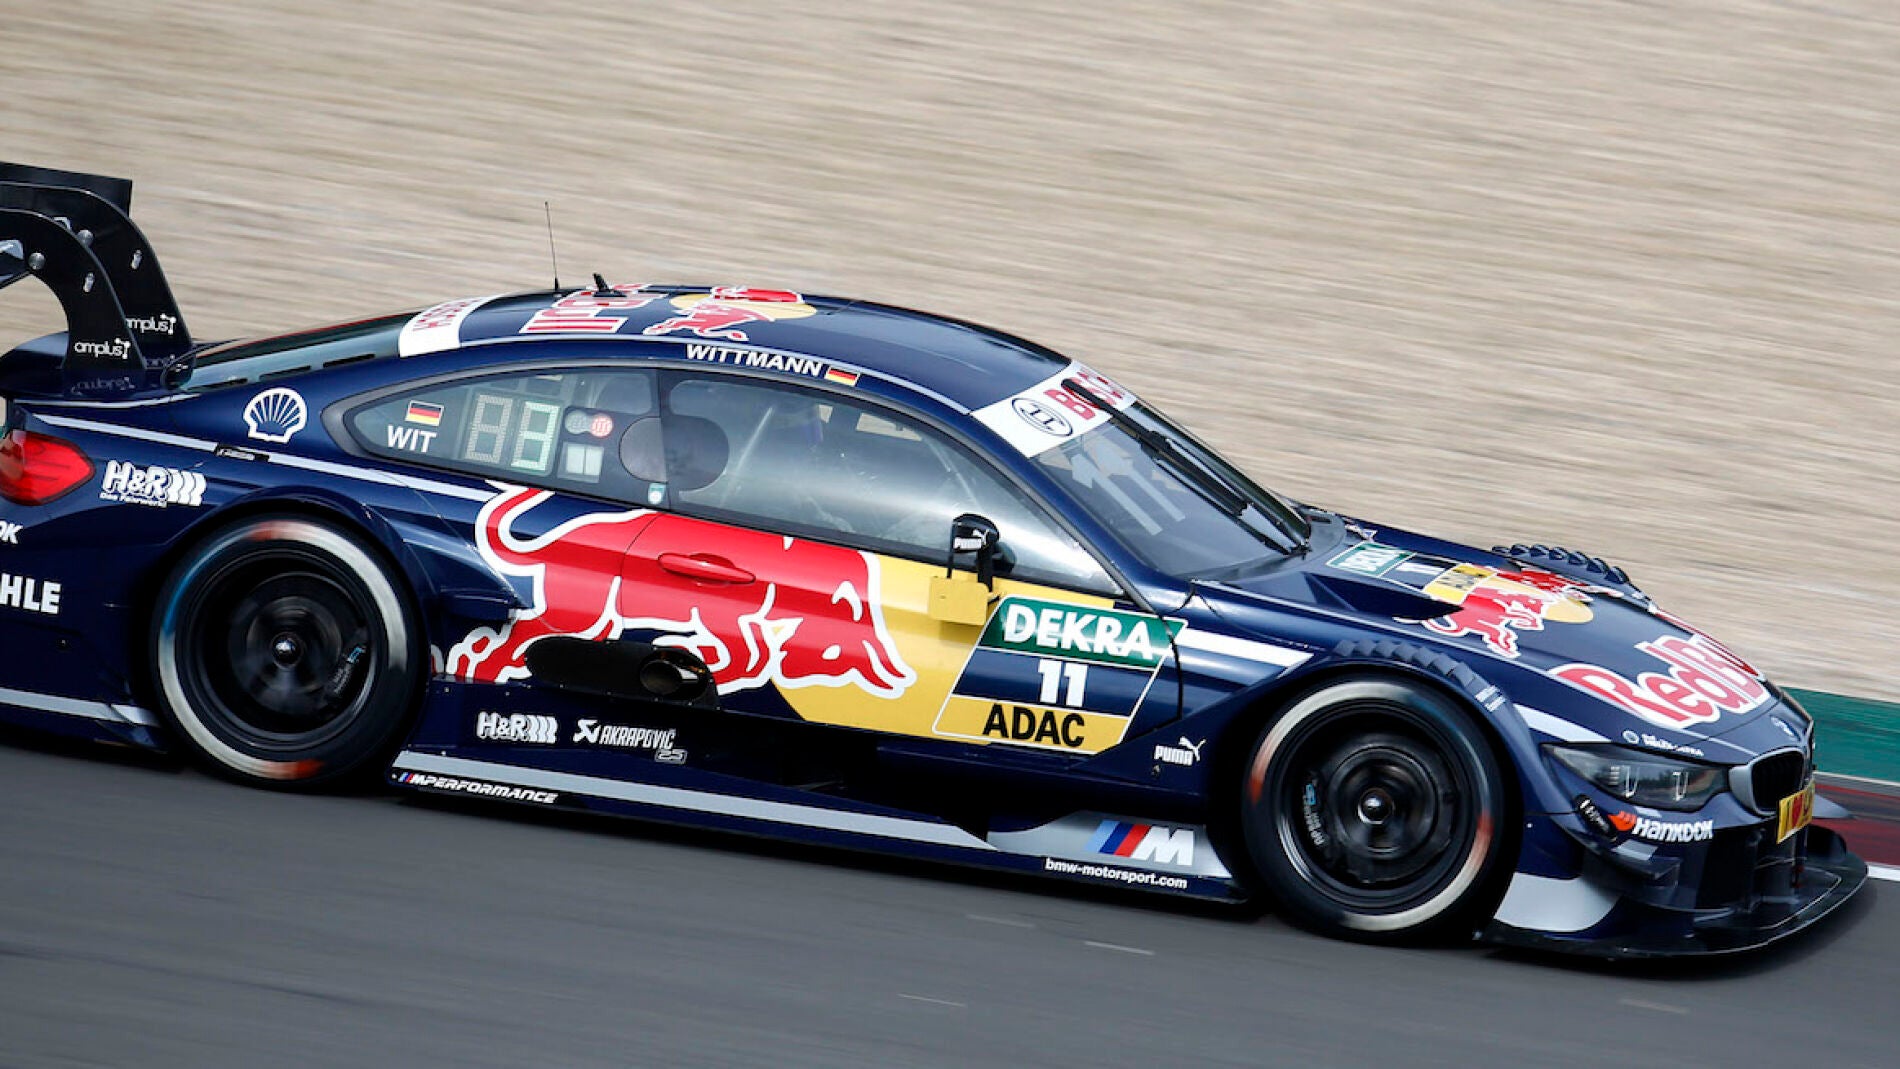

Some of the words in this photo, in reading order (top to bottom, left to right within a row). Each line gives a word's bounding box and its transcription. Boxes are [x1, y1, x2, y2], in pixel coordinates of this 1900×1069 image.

[686, 343, 822, 377] WITTMANN
[387, 424, 437, 453] WIT
[102, 459, 168, 500] H&R
[0, 572, 62, 614] HLE
[1003, 604, 1153, 659] DEKRA
[1038, 658, 1089, 708] 11
[476, 711, 526, 742] H&R
[982, 704, 1085, 747] ADAC
[1154, 745, 1194, 766] PUMA
[1044, 857, 1188, 889] bmw-motorsport.com
